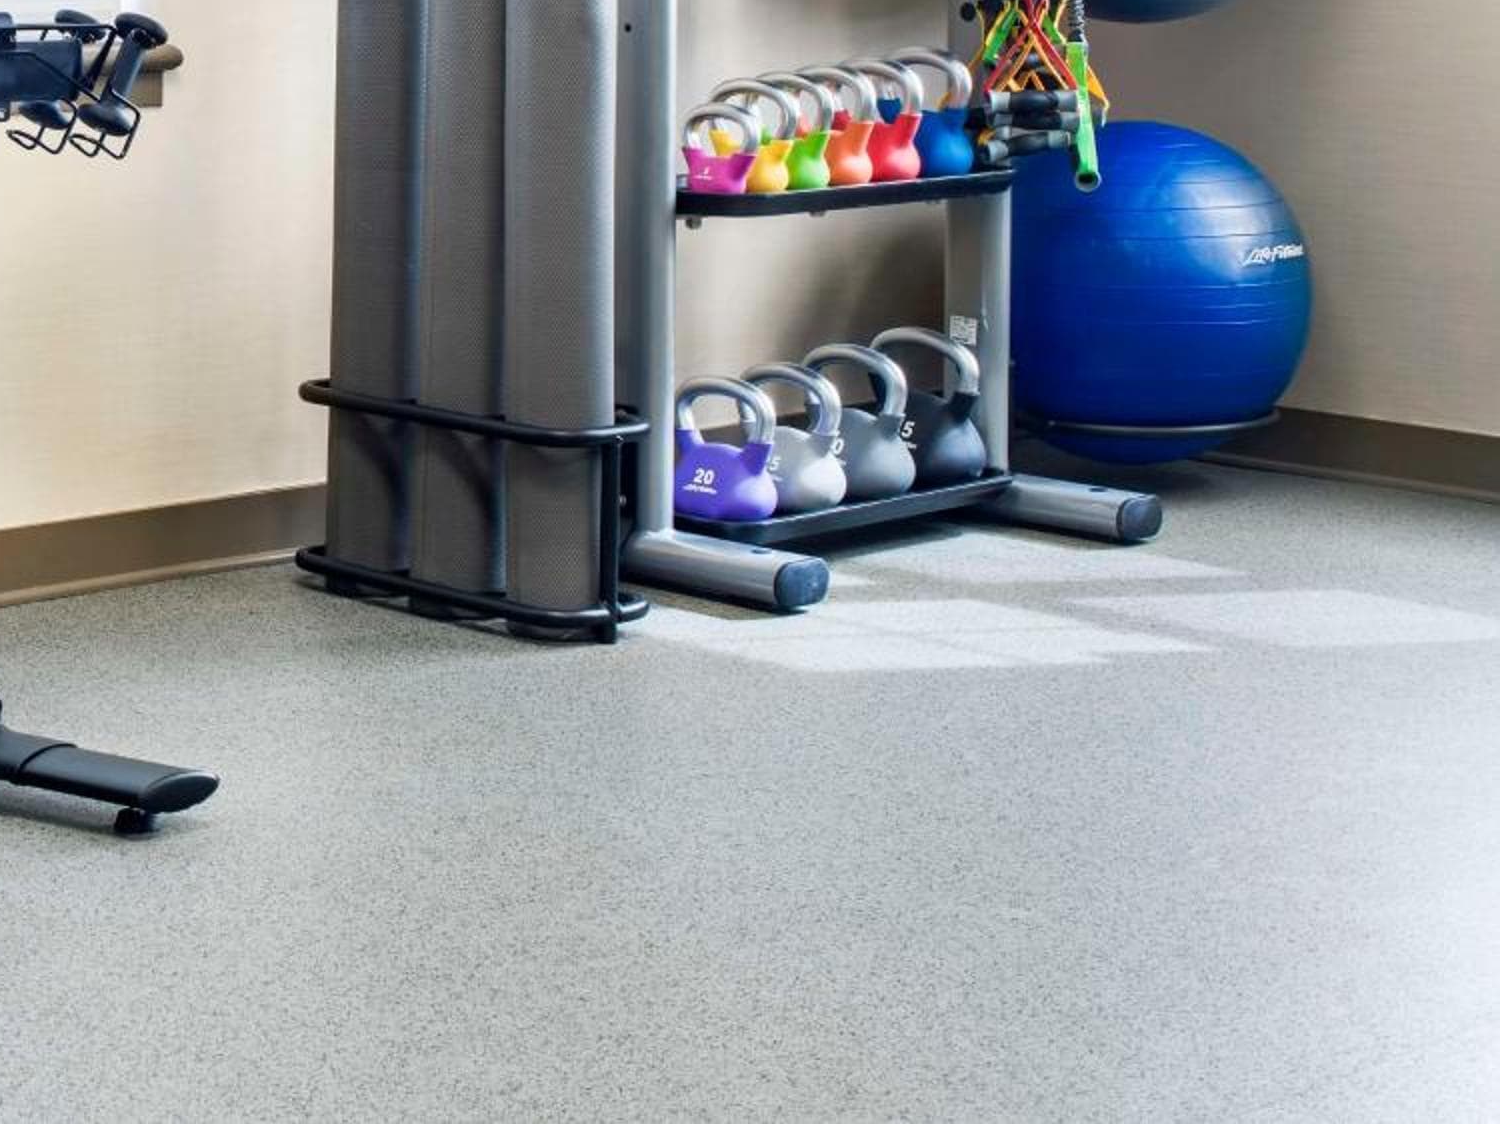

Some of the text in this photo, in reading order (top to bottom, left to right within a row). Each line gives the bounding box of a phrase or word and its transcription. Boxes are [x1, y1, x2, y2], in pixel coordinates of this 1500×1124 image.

[901, 421, 915, 438] 5
[768, 456, 781, 472] 5
[693, 467, 715, 485] 20
